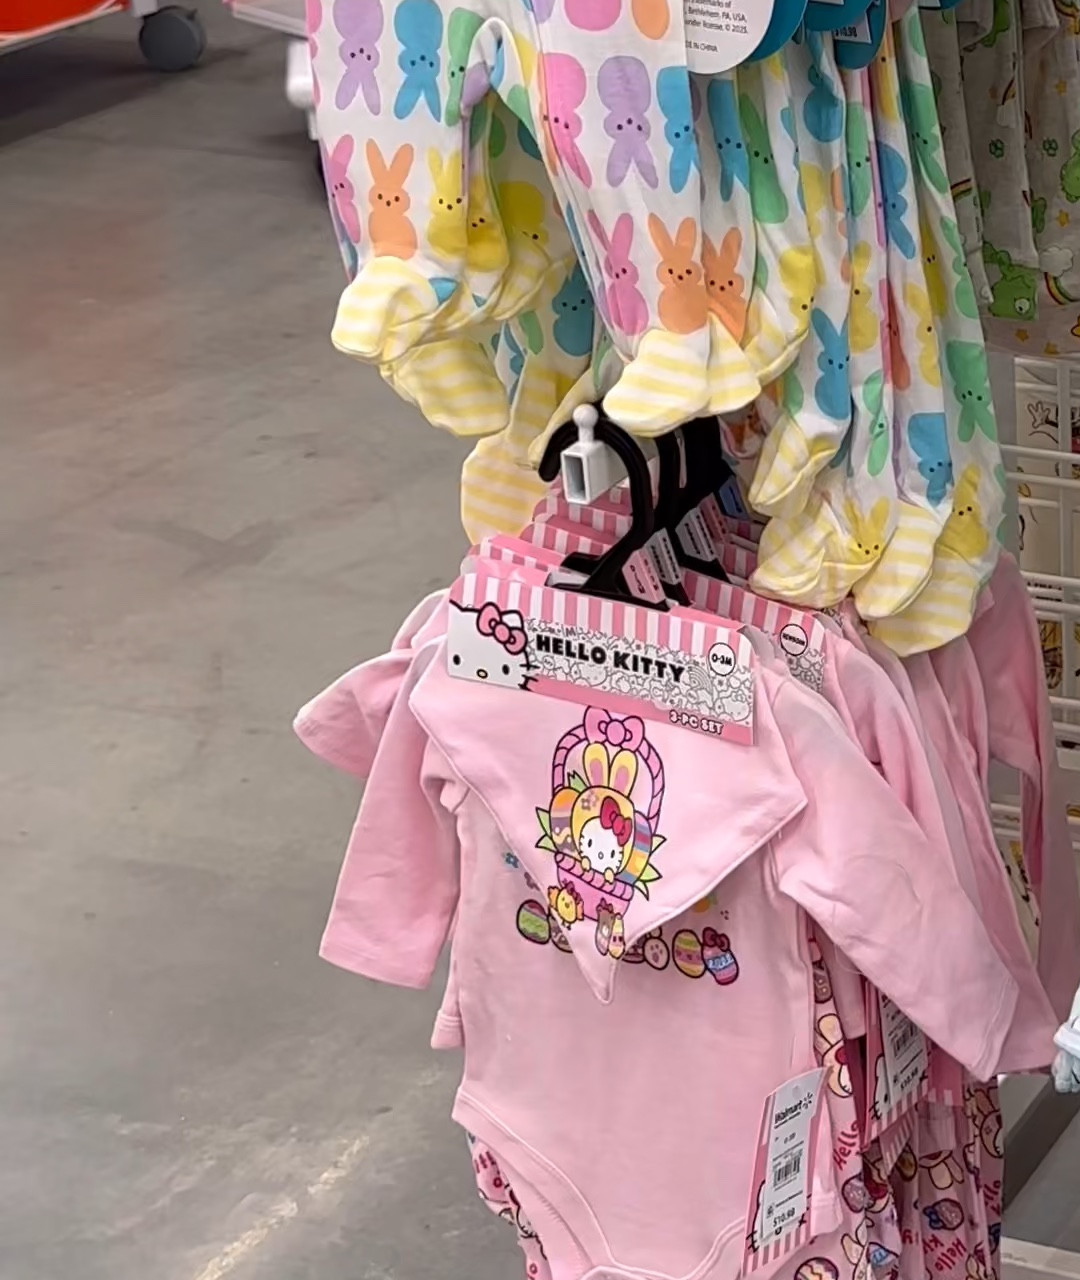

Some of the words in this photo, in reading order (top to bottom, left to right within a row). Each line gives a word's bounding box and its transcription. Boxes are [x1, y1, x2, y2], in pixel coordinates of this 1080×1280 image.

[535, 633, 607, 665] HELLO
[613, 650, 687, 683] KITTY
[711, 653, 733, 667] 0-3M
[669, 709, 699, 730] 3-PC
[701, 719, 724, 736] SET
